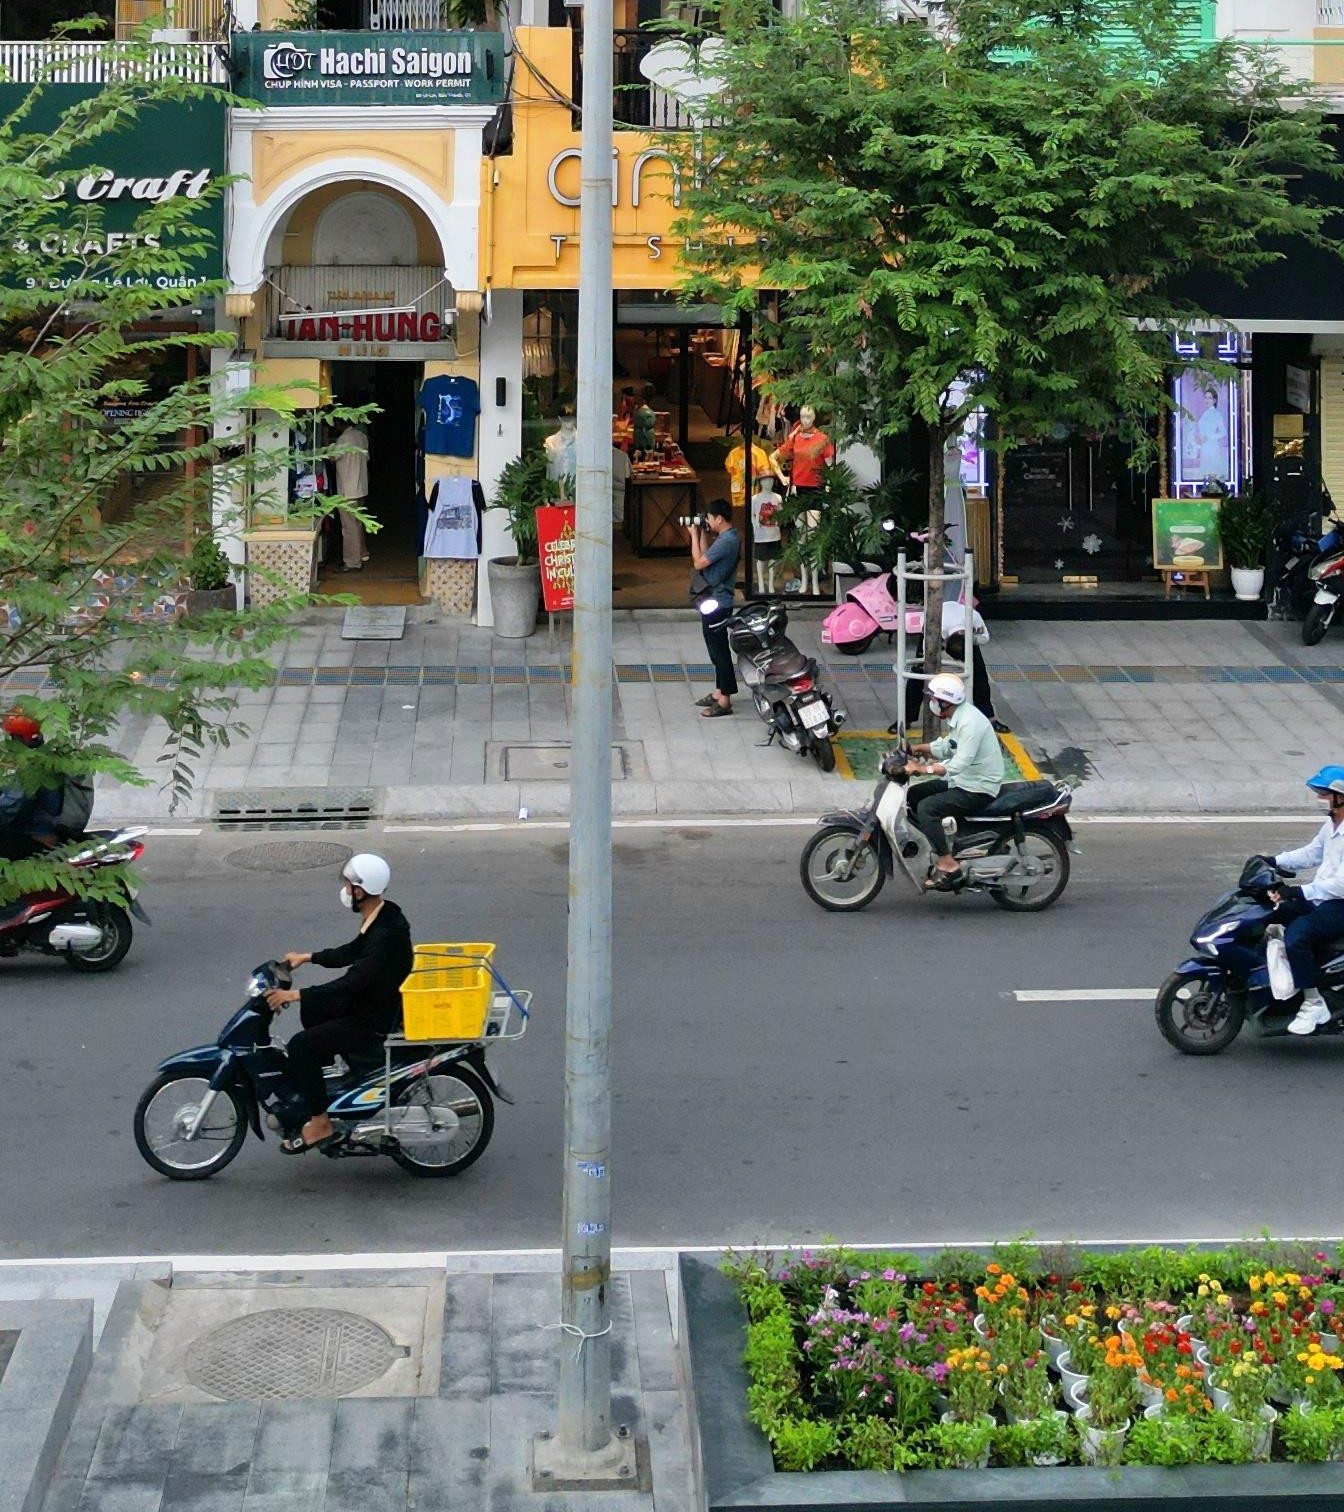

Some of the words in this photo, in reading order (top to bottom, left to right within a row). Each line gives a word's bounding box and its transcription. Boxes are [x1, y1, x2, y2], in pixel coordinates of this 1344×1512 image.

[321, 47, 386, 76] Hachi
[391, 47, 472, 78] Saigon
[320, 80, 342, 89] VISA
[350, 79, 399, 88] PASSPORT
[405, 79, 434, 88] WORK
[436, 78, 472, 88] PERMIT
[77, 169, 212, 204] Craft
